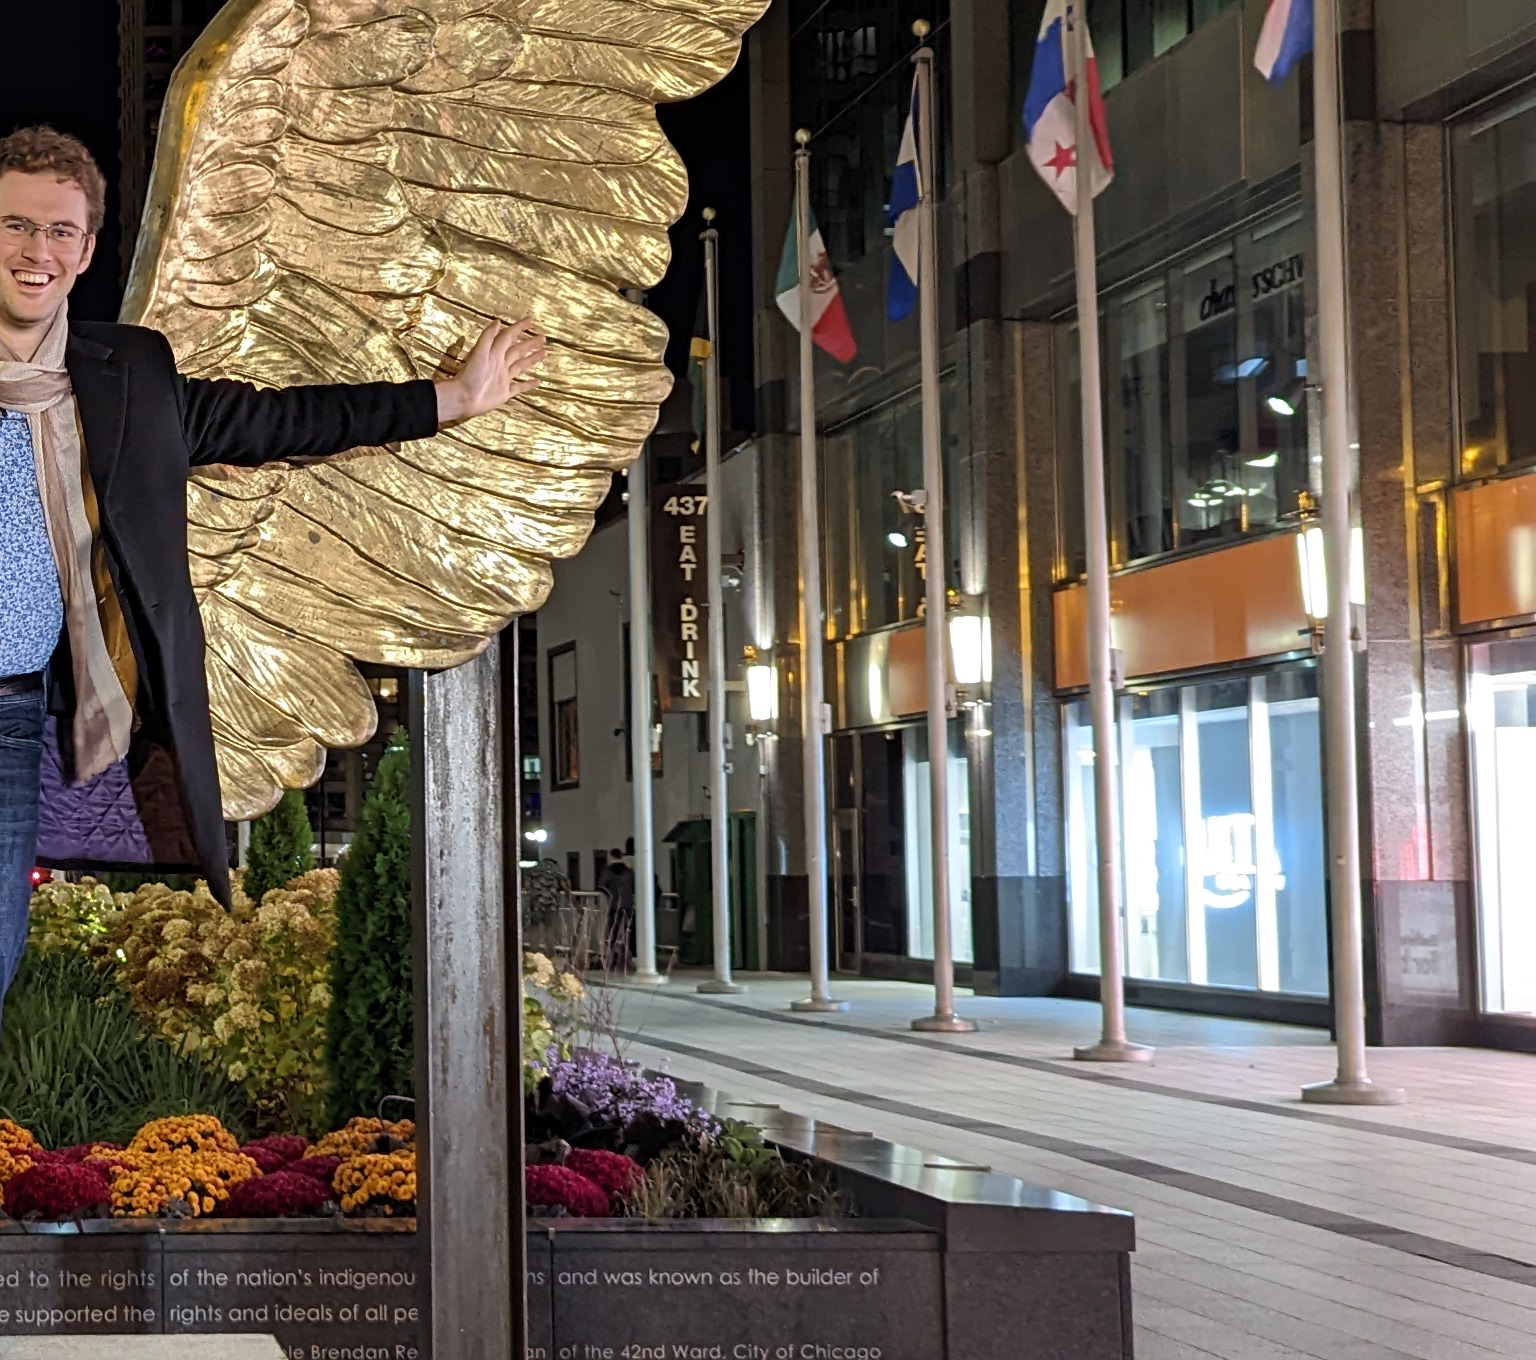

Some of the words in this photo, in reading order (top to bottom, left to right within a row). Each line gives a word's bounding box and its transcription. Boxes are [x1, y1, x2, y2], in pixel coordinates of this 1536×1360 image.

[663, 496, 709, 516] 437
[679, 525, 697, 581] EAT
[680, 604, 701, 698] DRINK
[29, 1270, 50, 1288] to
[59, 1270, 92, 1288] the
[101, 1269, 156, 1290] rights
[169, 1268, 190, 1287] of
[197, 1268, 229, 1287] the
[236, 1268, 313, 1287] nation's
[319, 1268, 416, 1289] indigenou
[558, 1268, 598, 1286] and
[603, 1270, 643, 1286] was
[648, 1268, 714, 1286] known
[719, 1270, 742, 1286] as
[748, 1268, 780, 1286] the
[786, 1268, 853, 1286] builder
[859, 1267, 880, 1286] of
[15, 1304, 118, 1327] supported
[123, 1305, 157, 1323] the
[169, 1304, 223, 1326] rights
[228, 1304, 269, 1322] and
[274, 1304, 333, 1322] ideals
[338, 1303, 360, 1322] of
[365, 1304, 388, 1322] all
[310, 1344, 390, 1360] Brendan
[558, 1343, 578, 1360] of
[585, 1344, 614, 1359] the
[621, 1344, 666, 1360] 42nd
[775, 1343, 795, 1360] of
